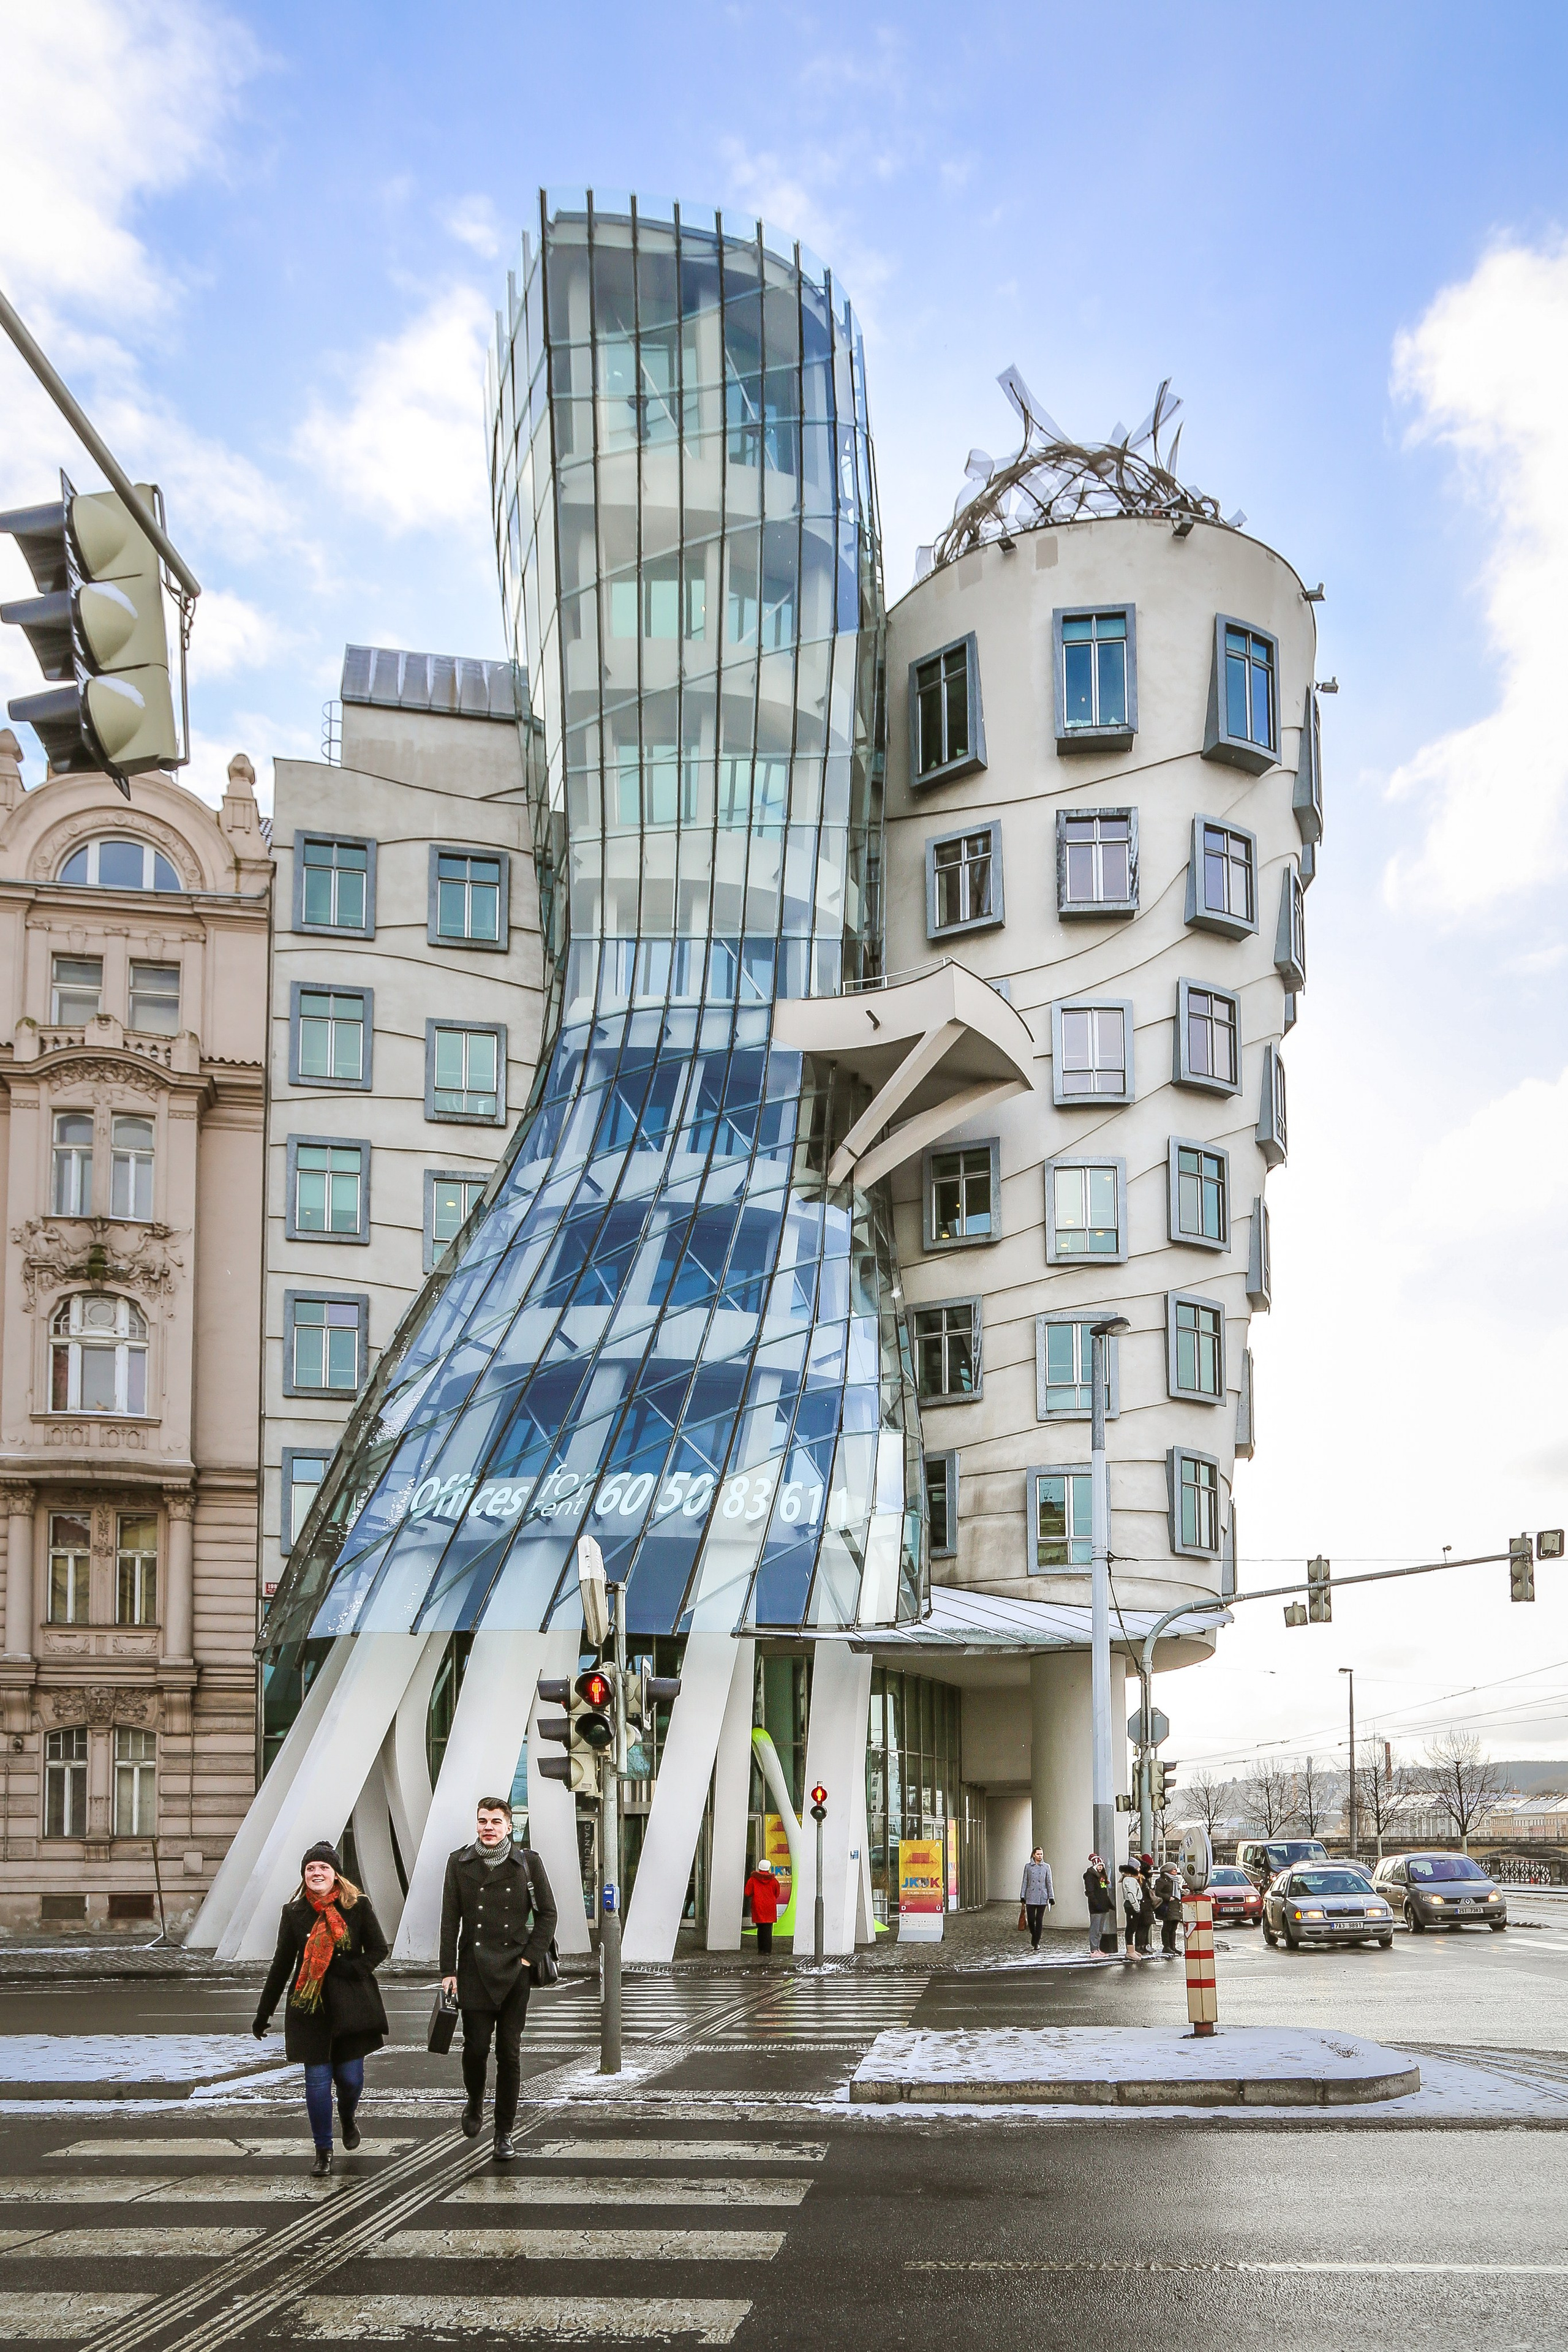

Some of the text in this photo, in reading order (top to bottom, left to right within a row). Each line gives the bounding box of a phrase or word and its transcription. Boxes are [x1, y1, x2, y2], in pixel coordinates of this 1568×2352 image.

[410, 1472, 530, 1518] Offices
[528, 1498, 585, 1517] rent
[595, 1471, 654, 1516] 60
[656, 1471, 715, 1517] 50
[722, 1476, 772, 1521] 83
